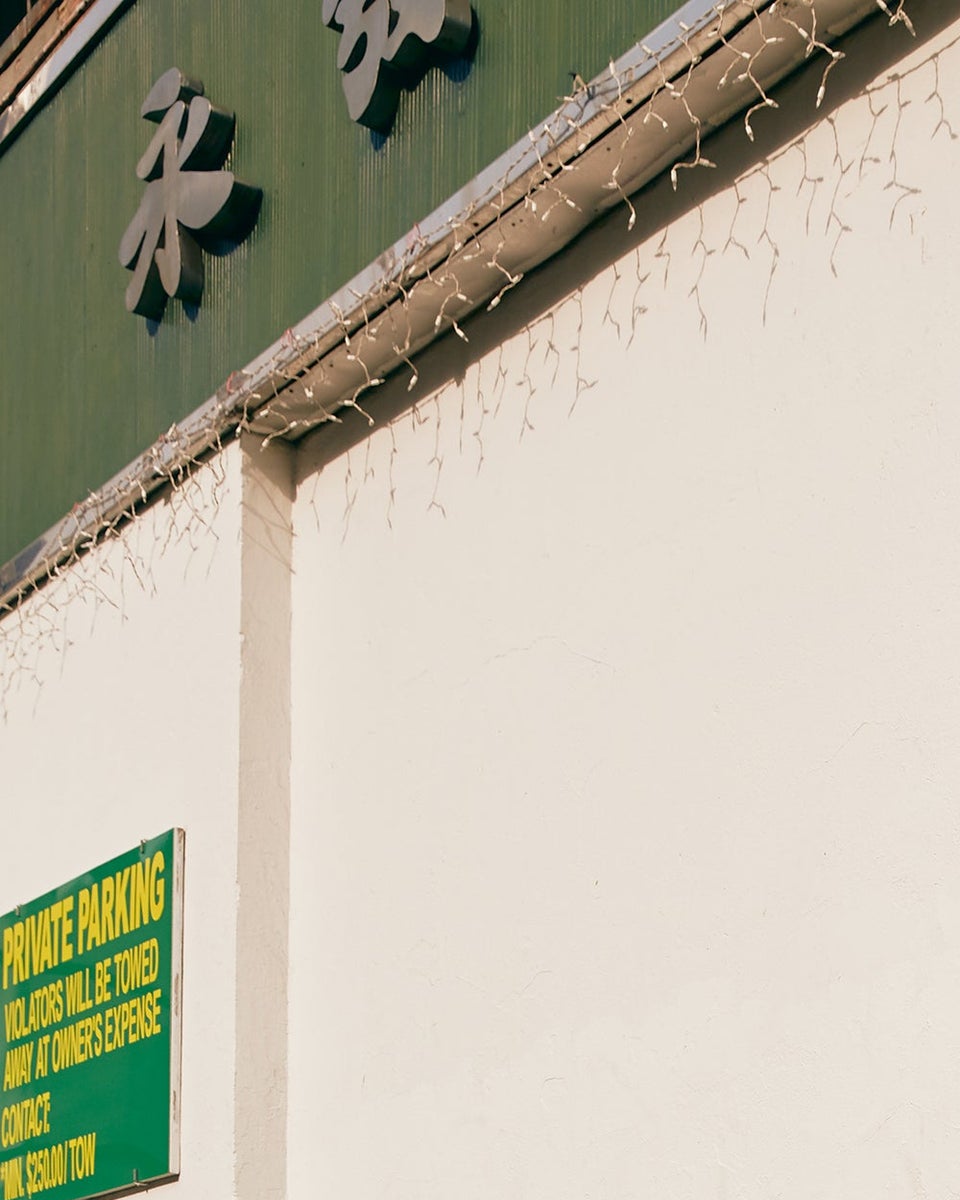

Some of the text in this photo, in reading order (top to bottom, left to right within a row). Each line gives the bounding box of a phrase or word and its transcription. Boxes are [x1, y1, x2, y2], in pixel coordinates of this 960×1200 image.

[3, 850, 165, 990] PRIVATE PARKING
[3, 988, 162, 1092] AWAY AT OWNER'S EXPENSE
[4, 937, 159, 1043] VIOLATORS WILL BE TOWED
[68, 1132, 97, 1181] TOW
